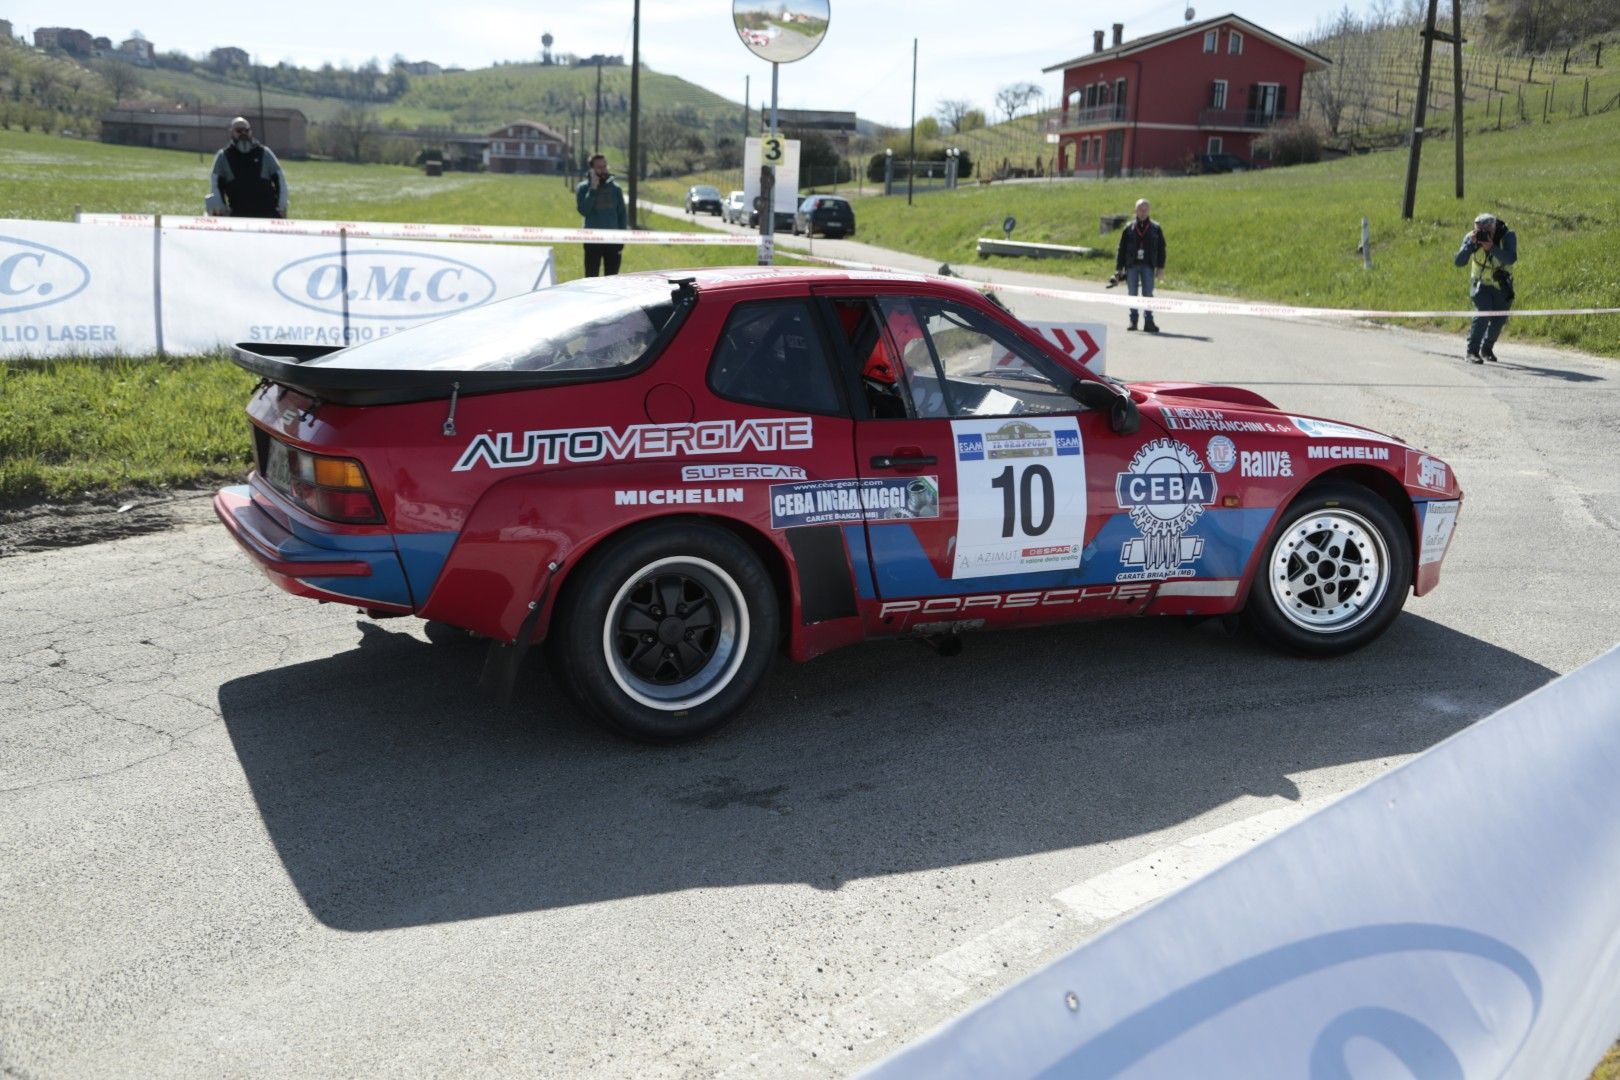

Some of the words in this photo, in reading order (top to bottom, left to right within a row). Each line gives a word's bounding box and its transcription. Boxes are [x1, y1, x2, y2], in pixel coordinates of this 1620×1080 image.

[765, 139, 781, 160] 3
[306, 263, 470, 302] O.M.C.
[46, 325, 117, 341] LASER
[250, 325, 374, 341] STAMPAGGIO
[1175, 407, 1202, 418] MERLO
[1180, 418, 1266, 432] LANFRANCHINI
[452, 417, 813, 472] AUTOVERGIATE
[959, 441, 983, 452] ESAM
[1056, 437, 1079, 447] ESAM
[1308, 446, 1389, 460] MICHELIN
[685, 466, 803, 480] SUPERCAR
[615, 488, 743, 505] MICHELIN
[1129, 477, 1205, 502] CEBA
[774, 491, 816, 517] CEBA
[817, 487, 906, 513] INGRANAGGI
[991, 463, 1055, 539] 10
[806, 514, 833, 523] CARATE
[1138, 504, 1197, 530] INGRANAGGI
[976, 549, 1019, 563] AZIMUT
[1029, 546, 1071, 556] DESPAR
[1117, 572, 1146, 581] CARATE
[1177, 569, 1195, 577] (MB)
[879, 584, 1153, 618] PORSCHE
